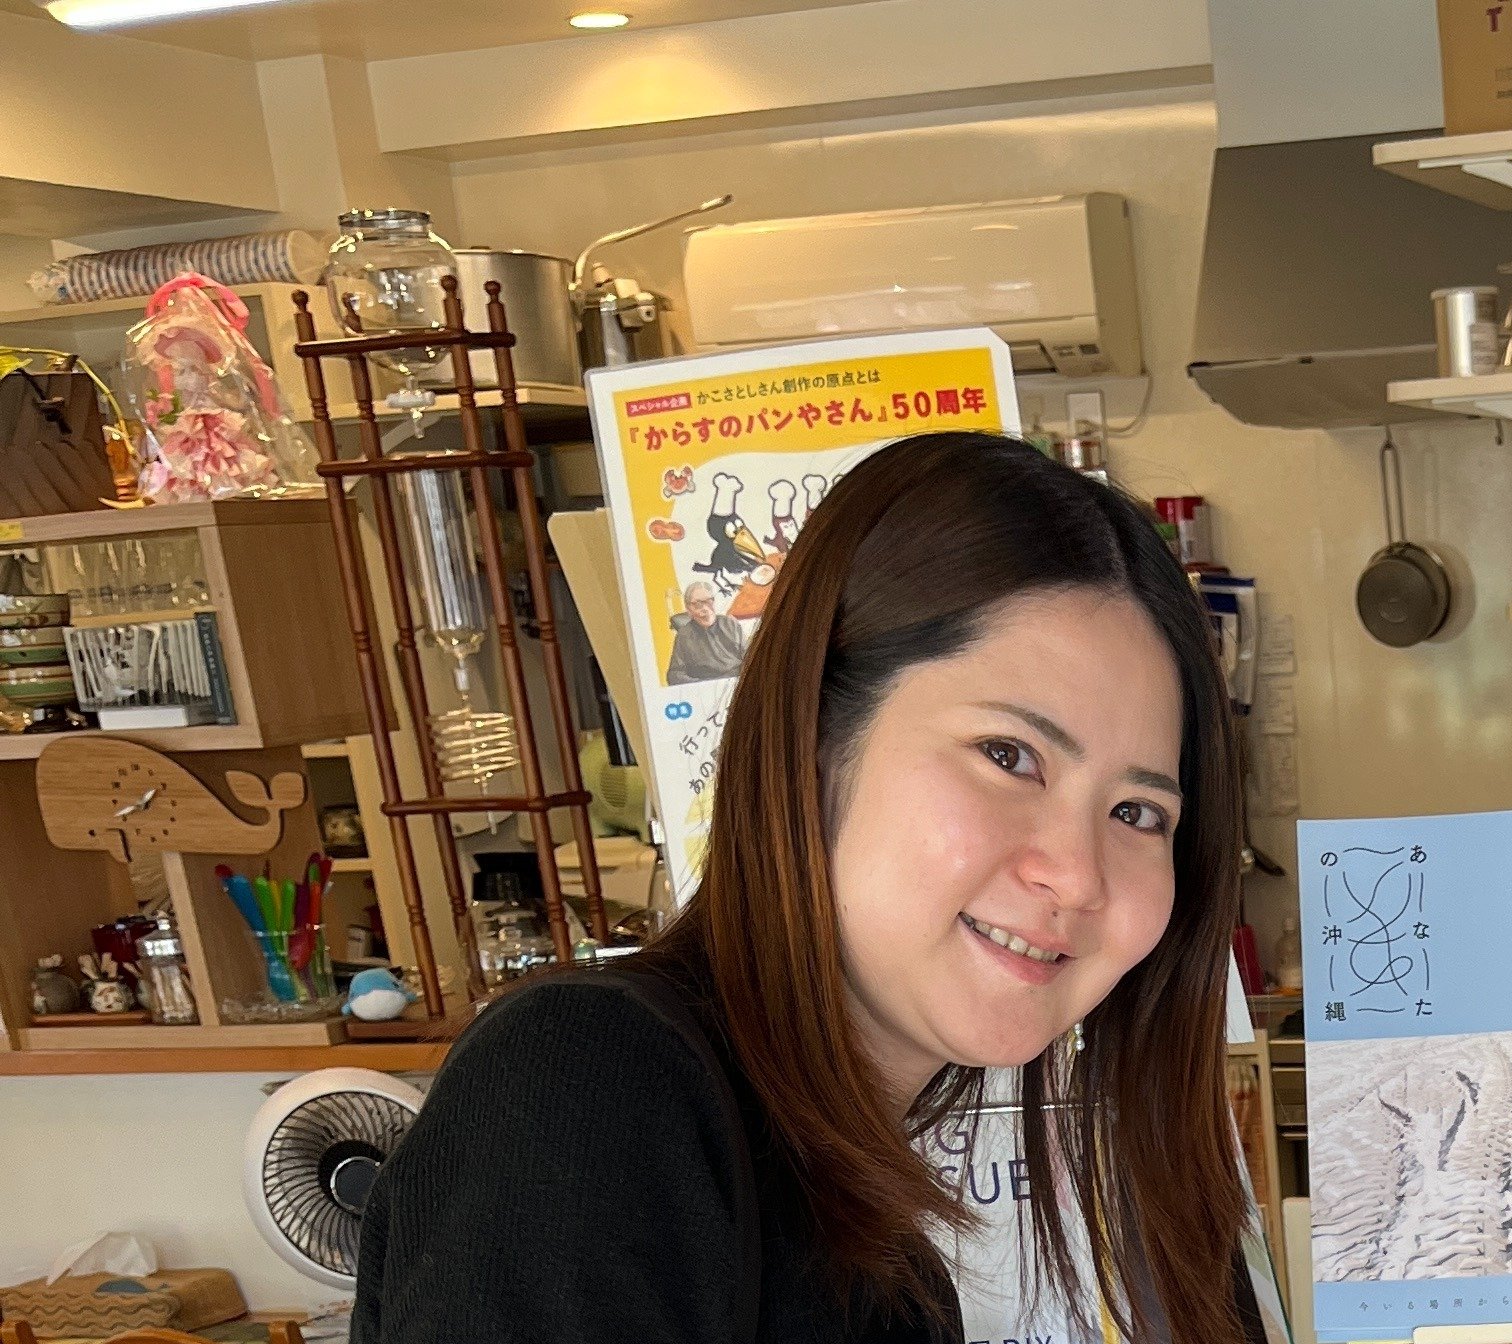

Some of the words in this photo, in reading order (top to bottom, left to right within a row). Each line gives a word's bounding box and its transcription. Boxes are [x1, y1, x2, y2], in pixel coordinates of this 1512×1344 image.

[696, 369, 882, 405] かこさとしさん創作の原点とは
